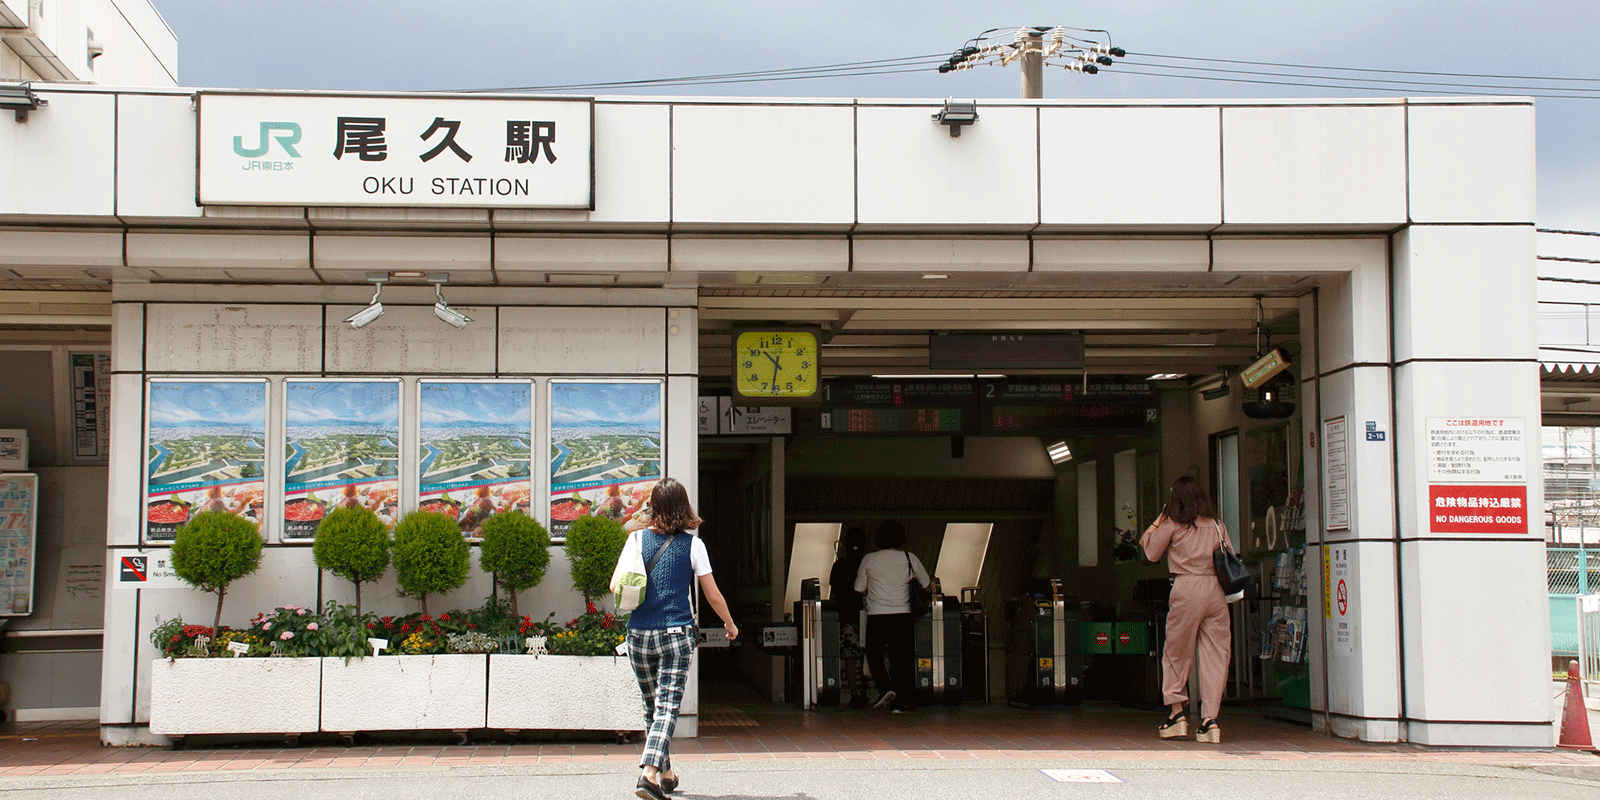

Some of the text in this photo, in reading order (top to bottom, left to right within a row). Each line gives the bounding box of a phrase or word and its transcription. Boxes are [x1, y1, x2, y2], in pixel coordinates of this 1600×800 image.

[232, 121, 303, 159] JR
[333, 116, 558, 164] 尾久駅
[242, 160, 294, 171] JR東日本
[363, 176, 529, 196] OKU STATION
[772, 337, 782, 345] 12
[750, 349, 760, 357] 10
[745, 361, 753, 369] 9
[801, 361, 809, 369] 3
[795, 374, 802, 382] 4
[761, 382, 769, 390] 7
[786, 382, 793, 390] 5
[986, 384, 995, 397] 2
[746, 416, 786, 424] エレベーター
[1446, 419, 1504, 427] ここは鉄道用地です
[1435, 497, 1522, 509] 危険物品持込厳禁
[1435, 514, 1522, 525] NO DANGEROUS GOODS
[157, 560, 166, 569] 禁
